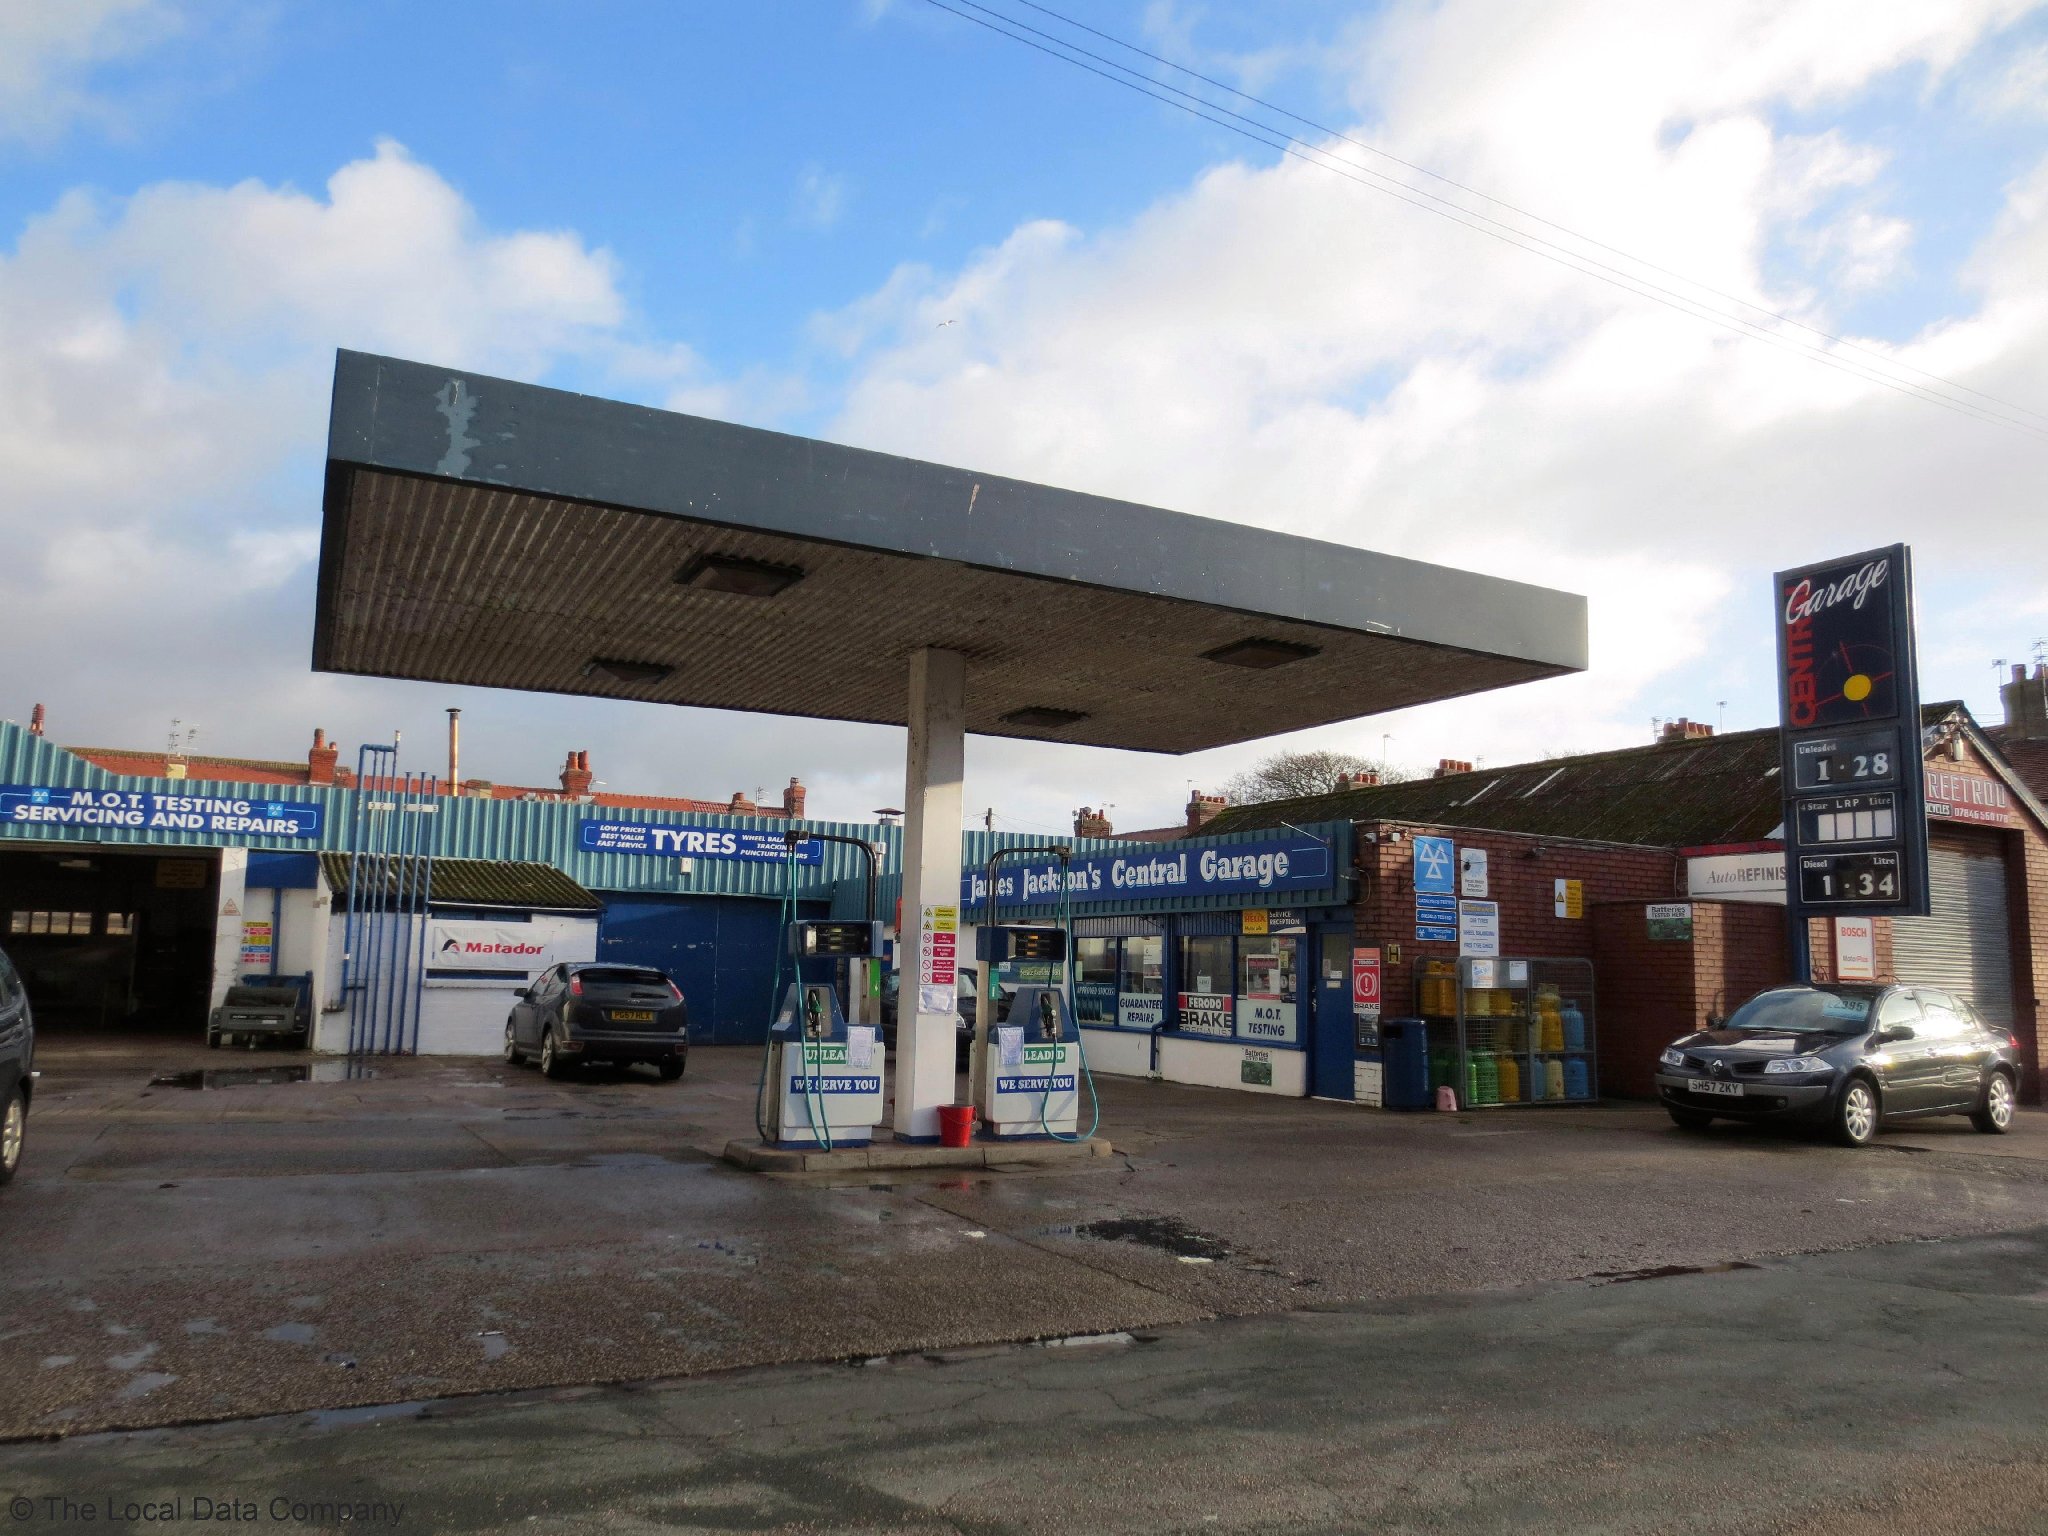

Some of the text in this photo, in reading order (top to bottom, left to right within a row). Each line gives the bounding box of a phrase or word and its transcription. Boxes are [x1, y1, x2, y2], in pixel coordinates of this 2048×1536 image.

[1786, 559, 1888, 624] Garage
[1799, 744, 1837, 754] Unleaded
[71, 791, 250, 815] M.O.T. TESTING
[1807, 802, 1828, 811] Star
[1869, 797, 1891, 806] Litre
[13, 805, 299, 834] SERVICING AND REPAIRS
[652, 829, 736, 855] TYRES
[742, 834, 765, 842] WHEEL
[617, 841, 648, 849] SERVICE
[740, 849, 778, 857] PUNCTURE
[1111, 853, 1187, 888] Central
[1200, 850, 1289, 887] Garage
[1803, 857, 1895, 869] Diesel Litre
[1706, 866, 1787, 884] AutoREFINIS
[1841, 927, 1867, 937] BOSCH
[465, 942, 544, 954] Matador
[1188, 998, 1222, 1010] FERODO
[1127, 1012, 1155, 1023] REPAIRS
[1254, 1007, 1281, 1020] M.O.T.
[1180, 1011, 1232, 1029] BRAKE
[1248, 1022, 1285, 1036] TESTING
[1245, 1049, 1268, 1058] Batteries
[794, 1080, 813, 1090] WE
[854, 1080, 878, 1090] YOU
[1000, 1078, 1072, 1090] WE SERVE YOU
[1692, 1081, 1738, 1094] SH57 ZKY
